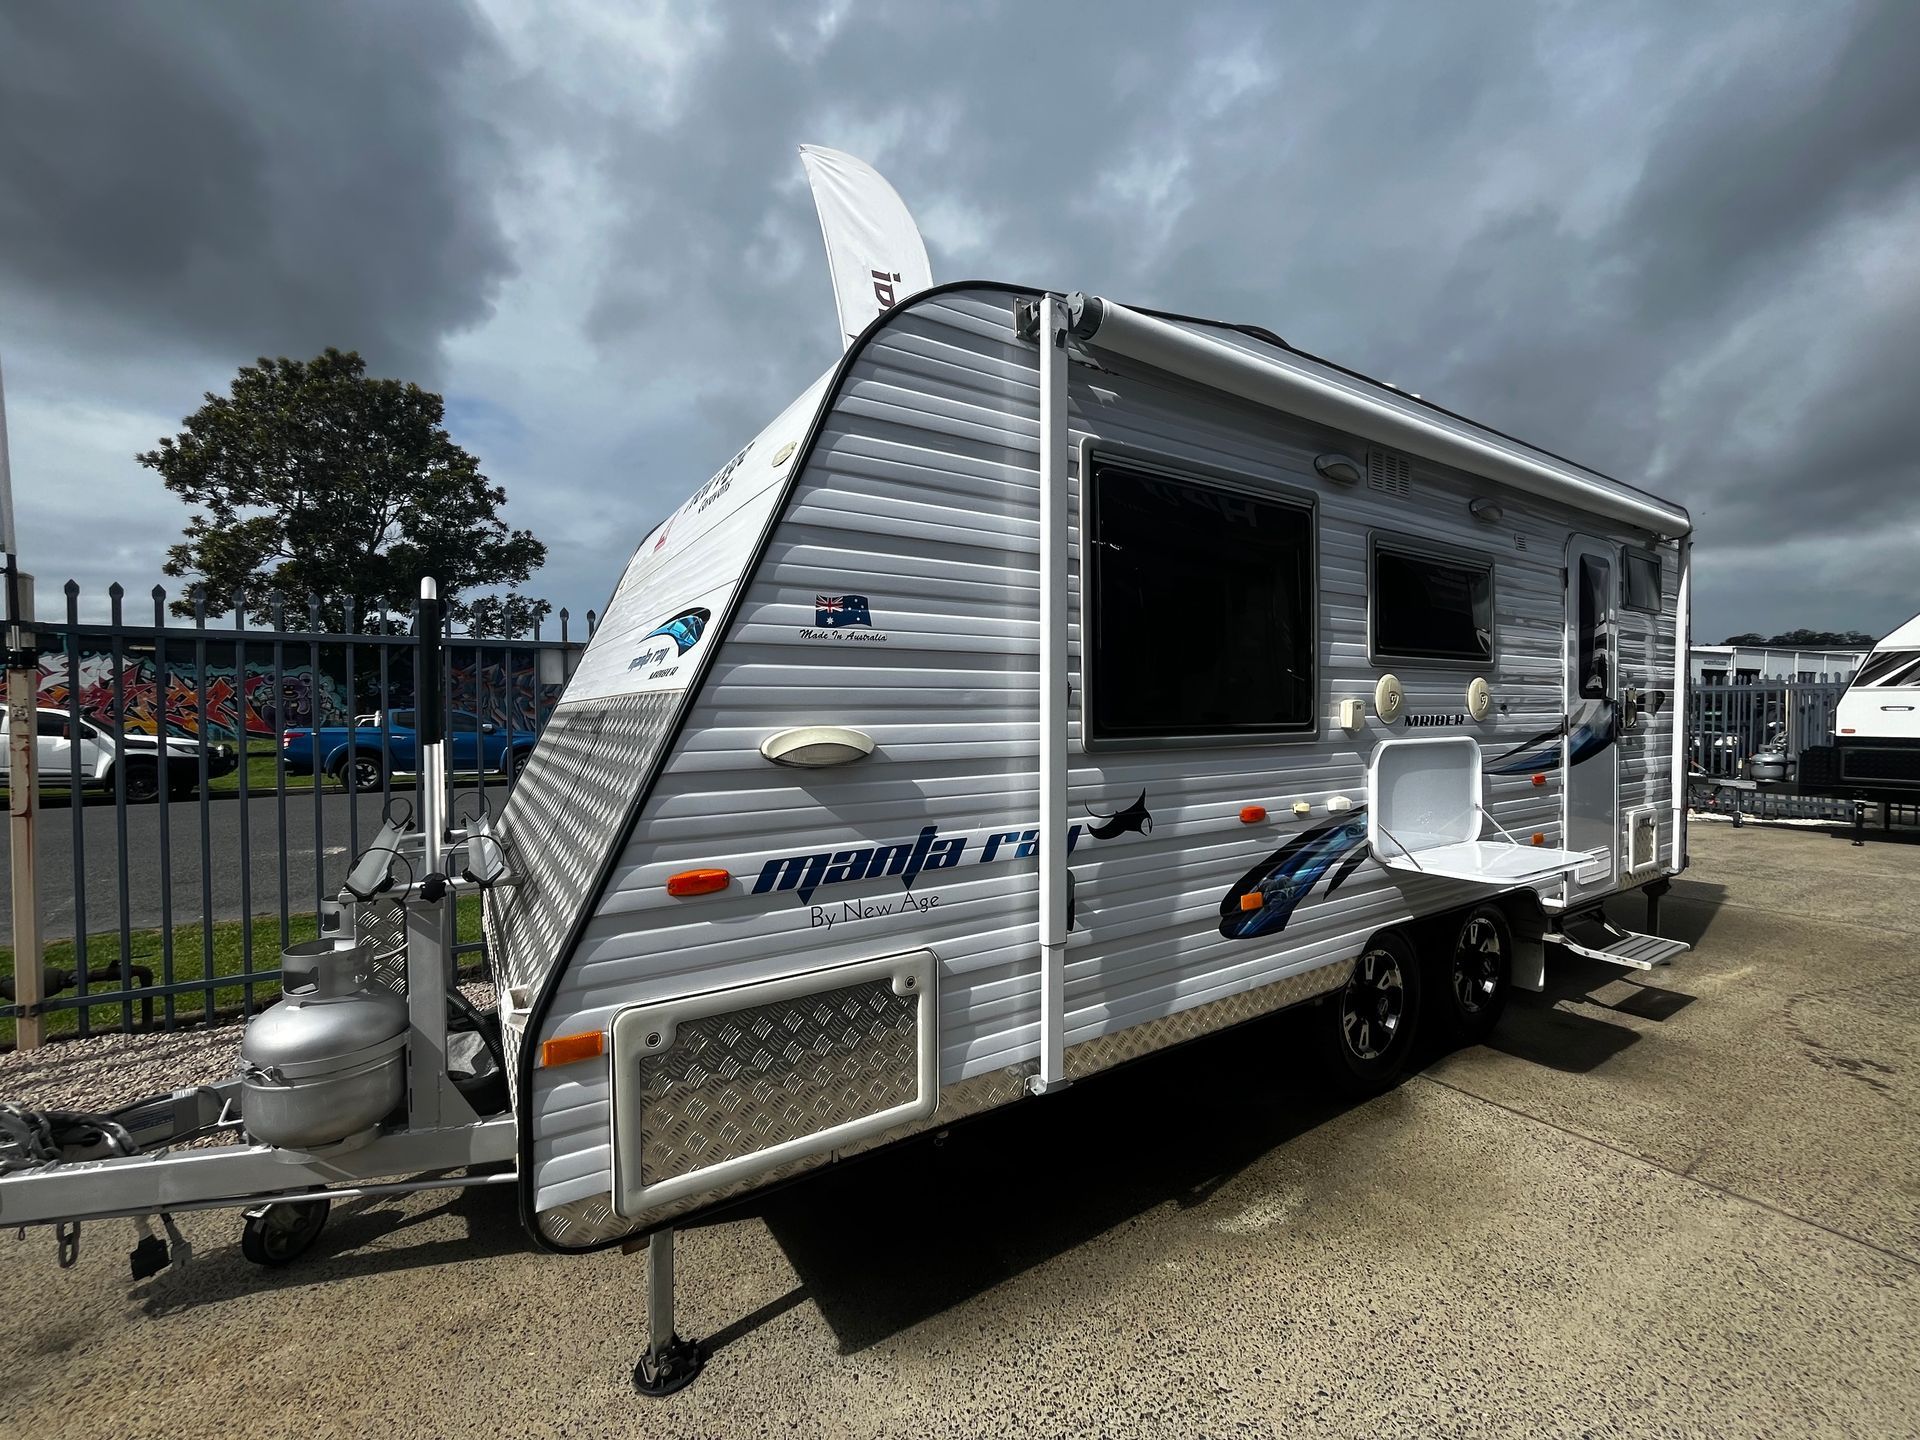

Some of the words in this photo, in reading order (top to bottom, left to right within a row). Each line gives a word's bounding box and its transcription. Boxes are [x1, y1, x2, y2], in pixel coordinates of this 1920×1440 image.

[800, 629, 828, 640] Made
[832, 630, 843, 640] In
[845, 631, 888, 642] Australia
[751, 826, 967, 905] manta
[811, 905, 836, 930] By
[844, 898, 893, 923] New
[901, 891, 940, 913] Age
